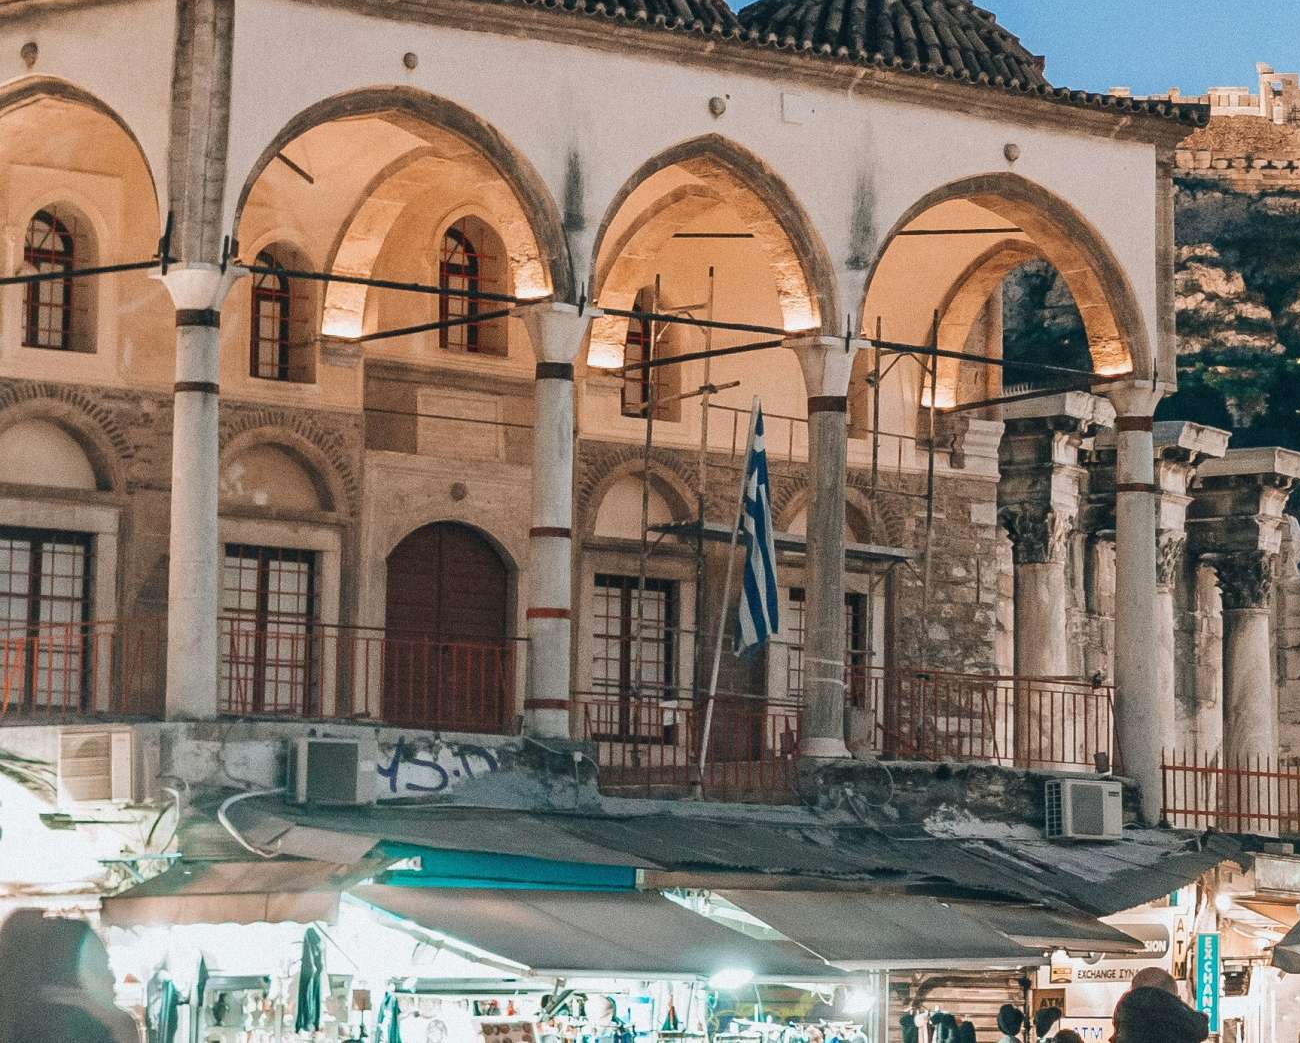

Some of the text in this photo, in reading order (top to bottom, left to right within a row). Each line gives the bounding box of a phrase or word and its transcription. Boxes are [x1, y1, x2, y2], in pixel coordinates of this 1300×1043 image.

[1077, 968, 1116, 979] EXCHANGE
[1173, 917, 1187, 977] ATM
[1202, 936, 1213, 1033] EXCHANG
